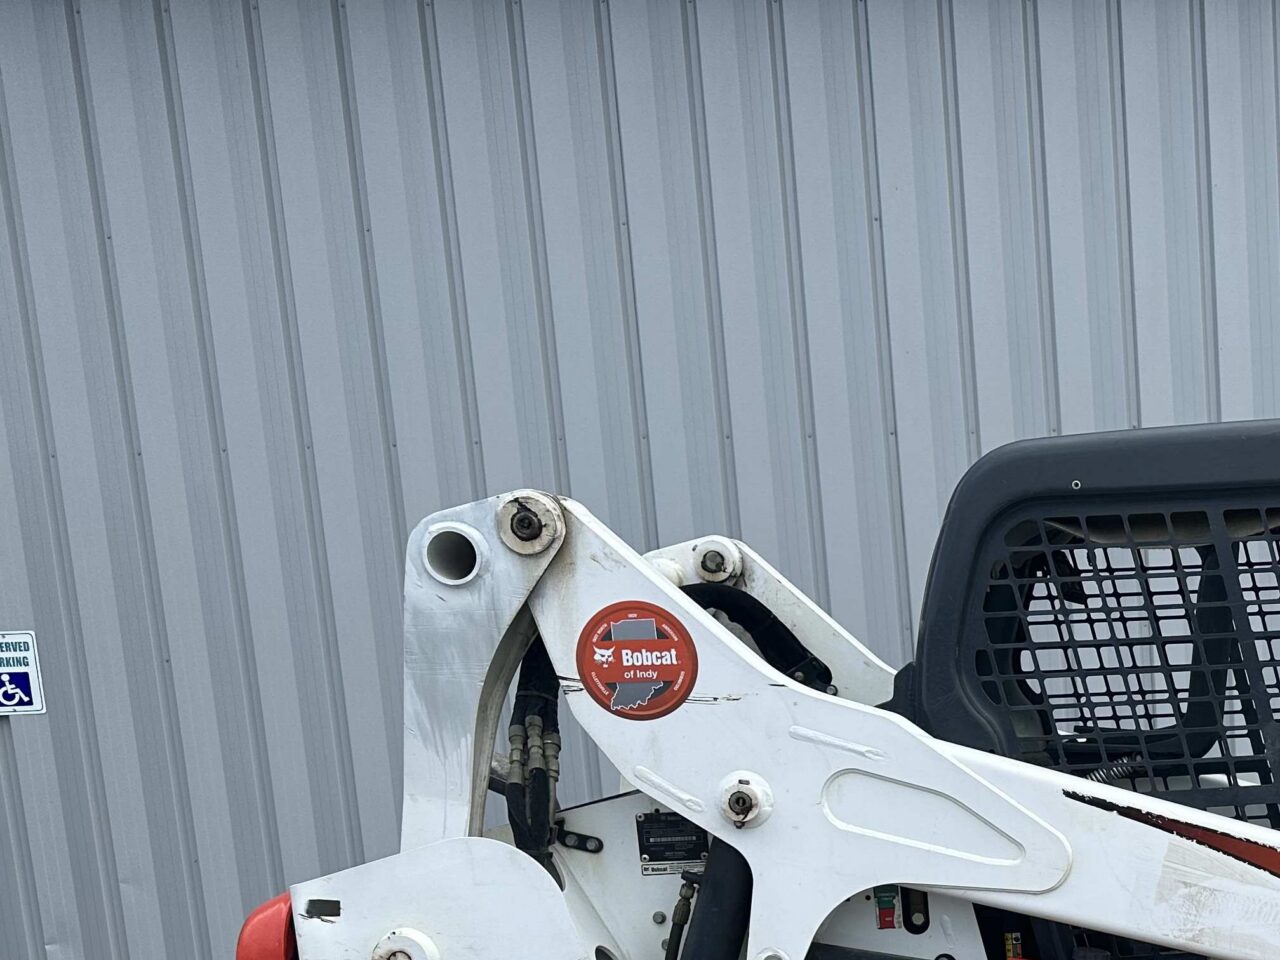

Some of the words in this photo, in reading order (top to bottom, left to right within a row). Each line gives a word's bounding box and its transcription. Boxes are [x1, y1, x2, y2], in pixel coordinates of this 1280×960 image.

[621, 648, 678, 667] Bobcat
[624, 670, 634, 679] of
[636, 669, 658, 680] Indy
